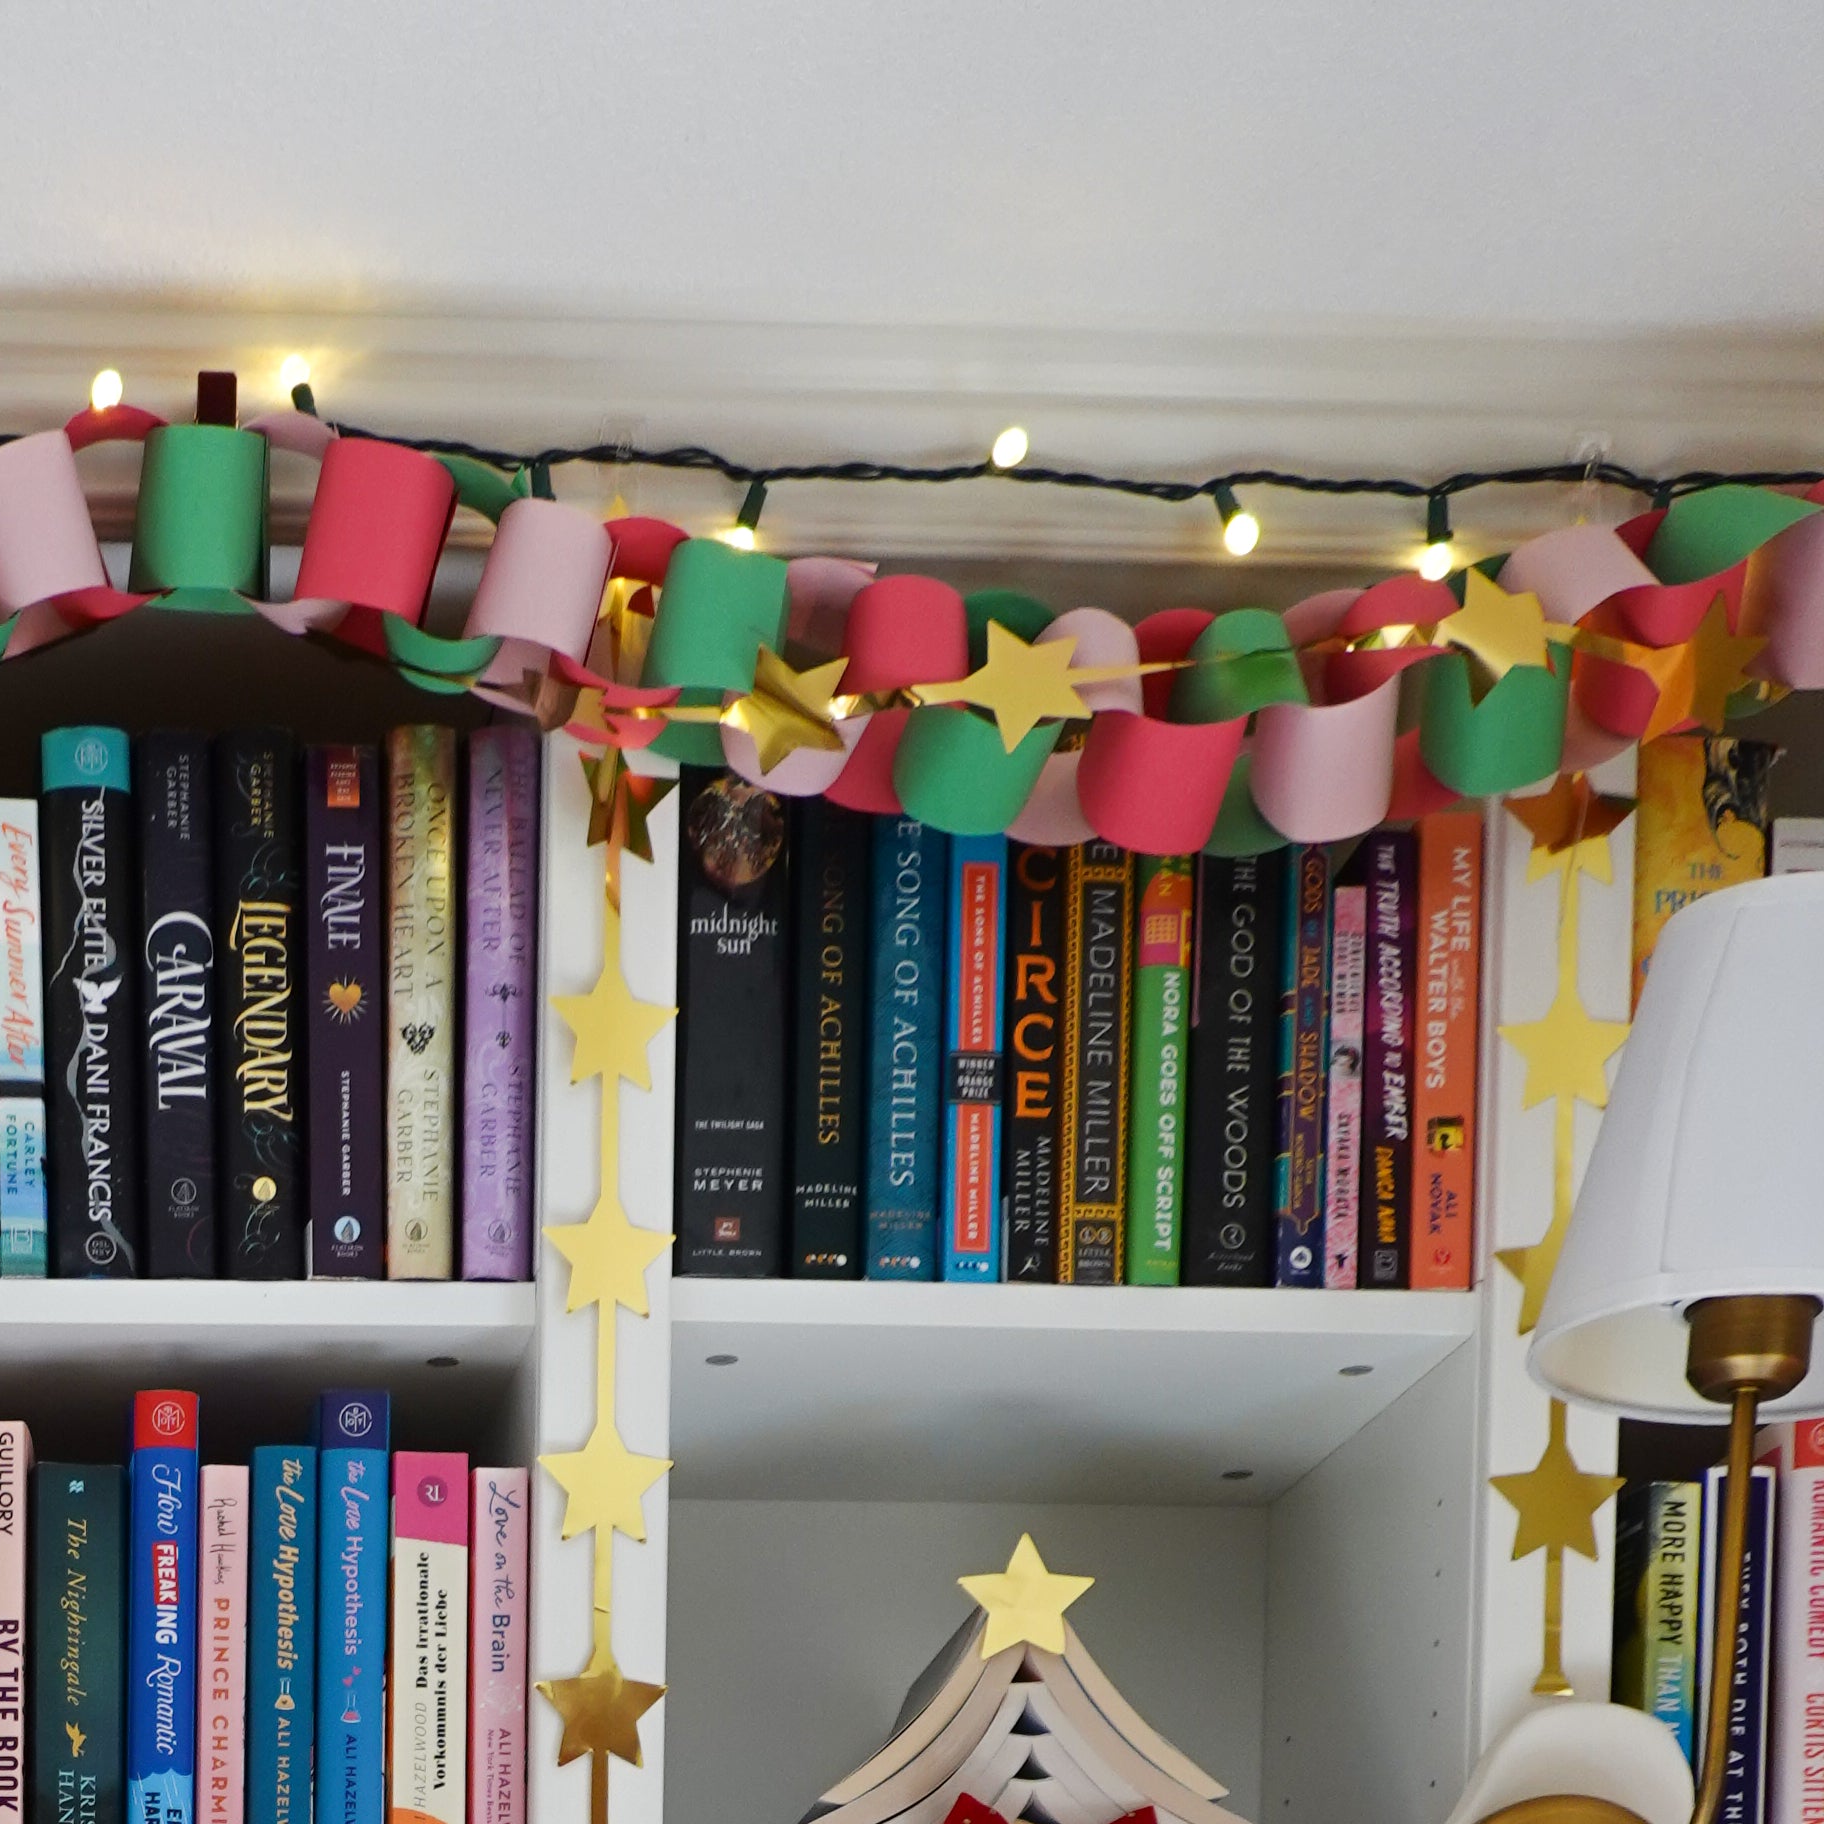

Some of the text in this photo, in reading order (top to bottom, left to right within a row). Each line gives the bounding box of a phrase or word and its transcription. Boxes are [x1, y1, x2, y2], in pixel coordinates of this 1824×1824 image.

[321, 842, 365, 950] FINALE
[690, 905, 778, 945] midnight
[716, 936, 752, 955] sun
[145, 911, 214, 1110] CARAVAL
[229, 900, 293, 1122] LEGENDARY
[1085, 888, 1116, 1196] MADELINE MILLER
[87, 1026, 112, 1221] DANI FRANCIS
[340, 1070, 351, 1196] STEPHANIE GARBER
[694, 1168, 764, 1177] STEPHENIE
[1155, 971, 1180, 1252] NORA GOES OFF SCRIPT
[694, 1178, 764, 1192] MEYER
[416, 1552, 430, 1688] Das irrationale
[433, 1589, 447, 1790] Vorkommnis der Liebe
